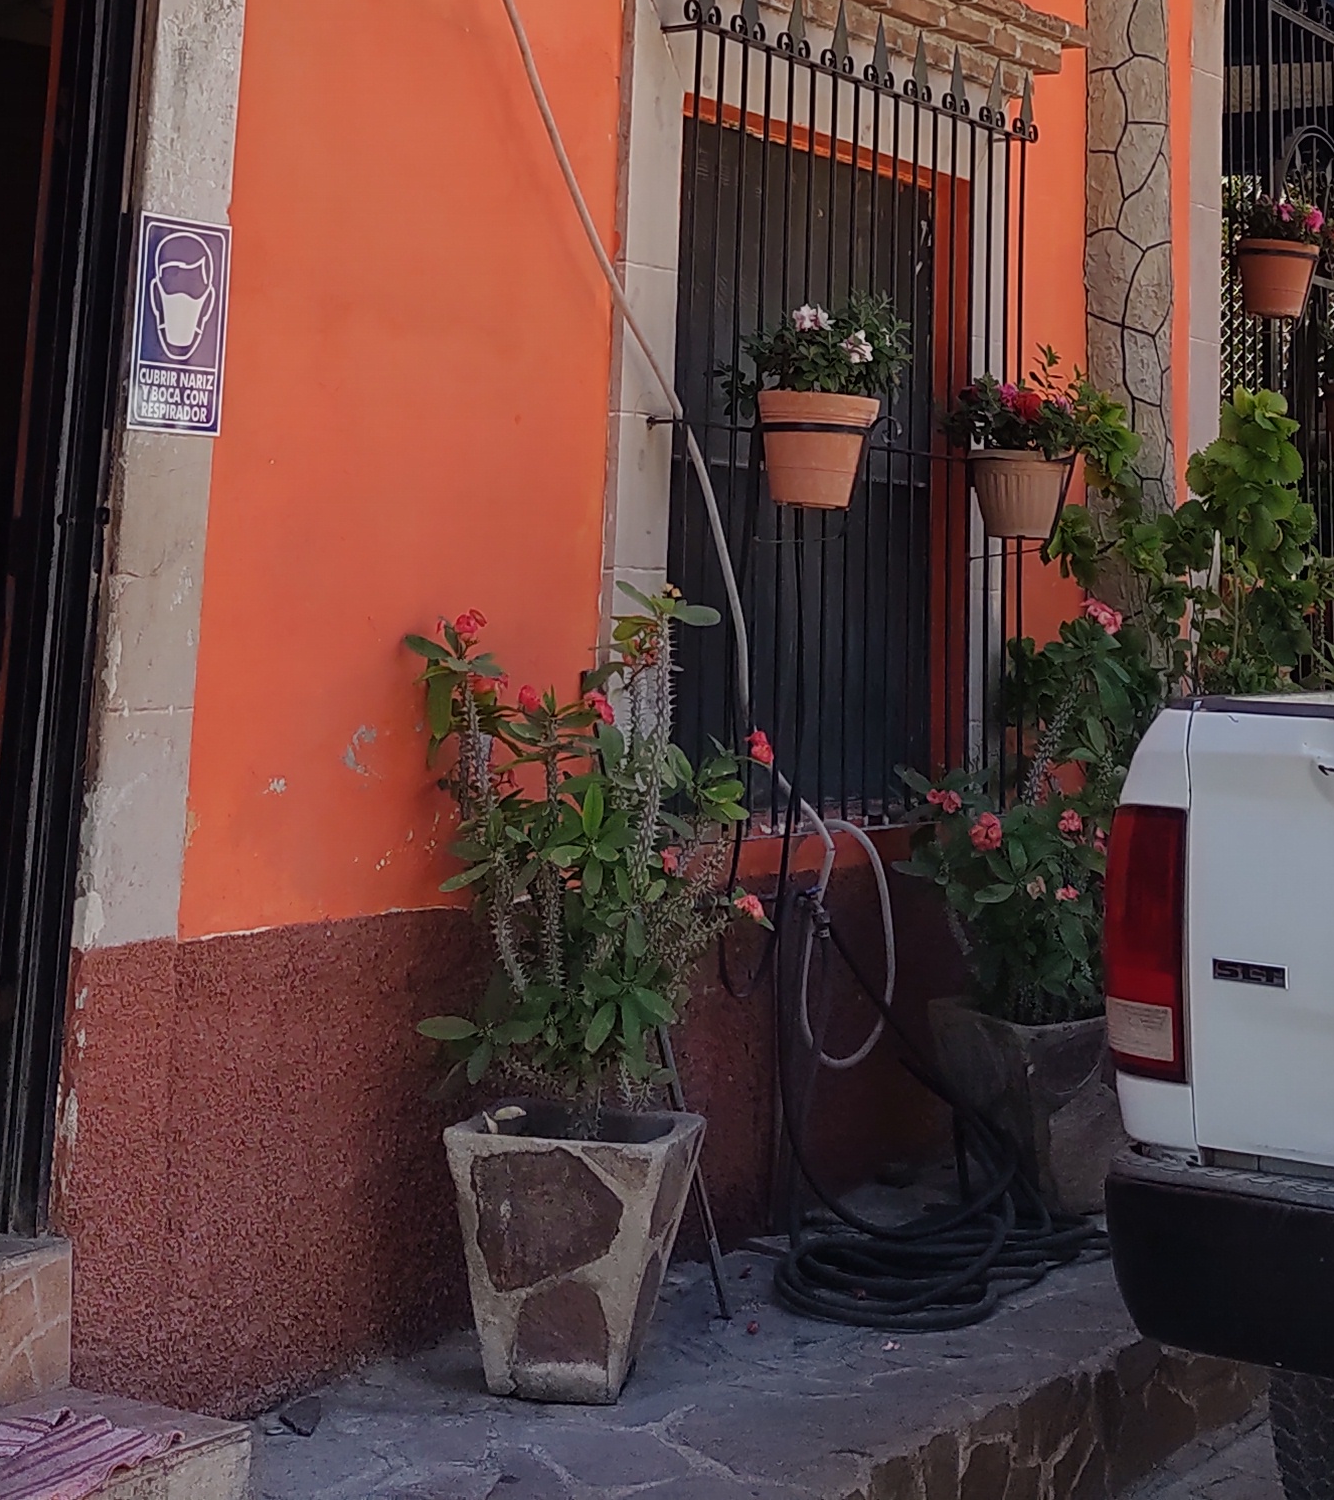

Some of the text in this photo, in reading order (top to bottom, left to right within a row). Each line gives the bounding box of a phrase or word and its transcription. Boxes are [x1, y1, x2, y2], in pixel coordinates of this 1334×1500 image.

[139, 367, 214, 390] CUBRIR NARIZ
[140, 383, 209, 406] Y BOCA CON
[140, 401, 207, 422] RESPIRADOR
